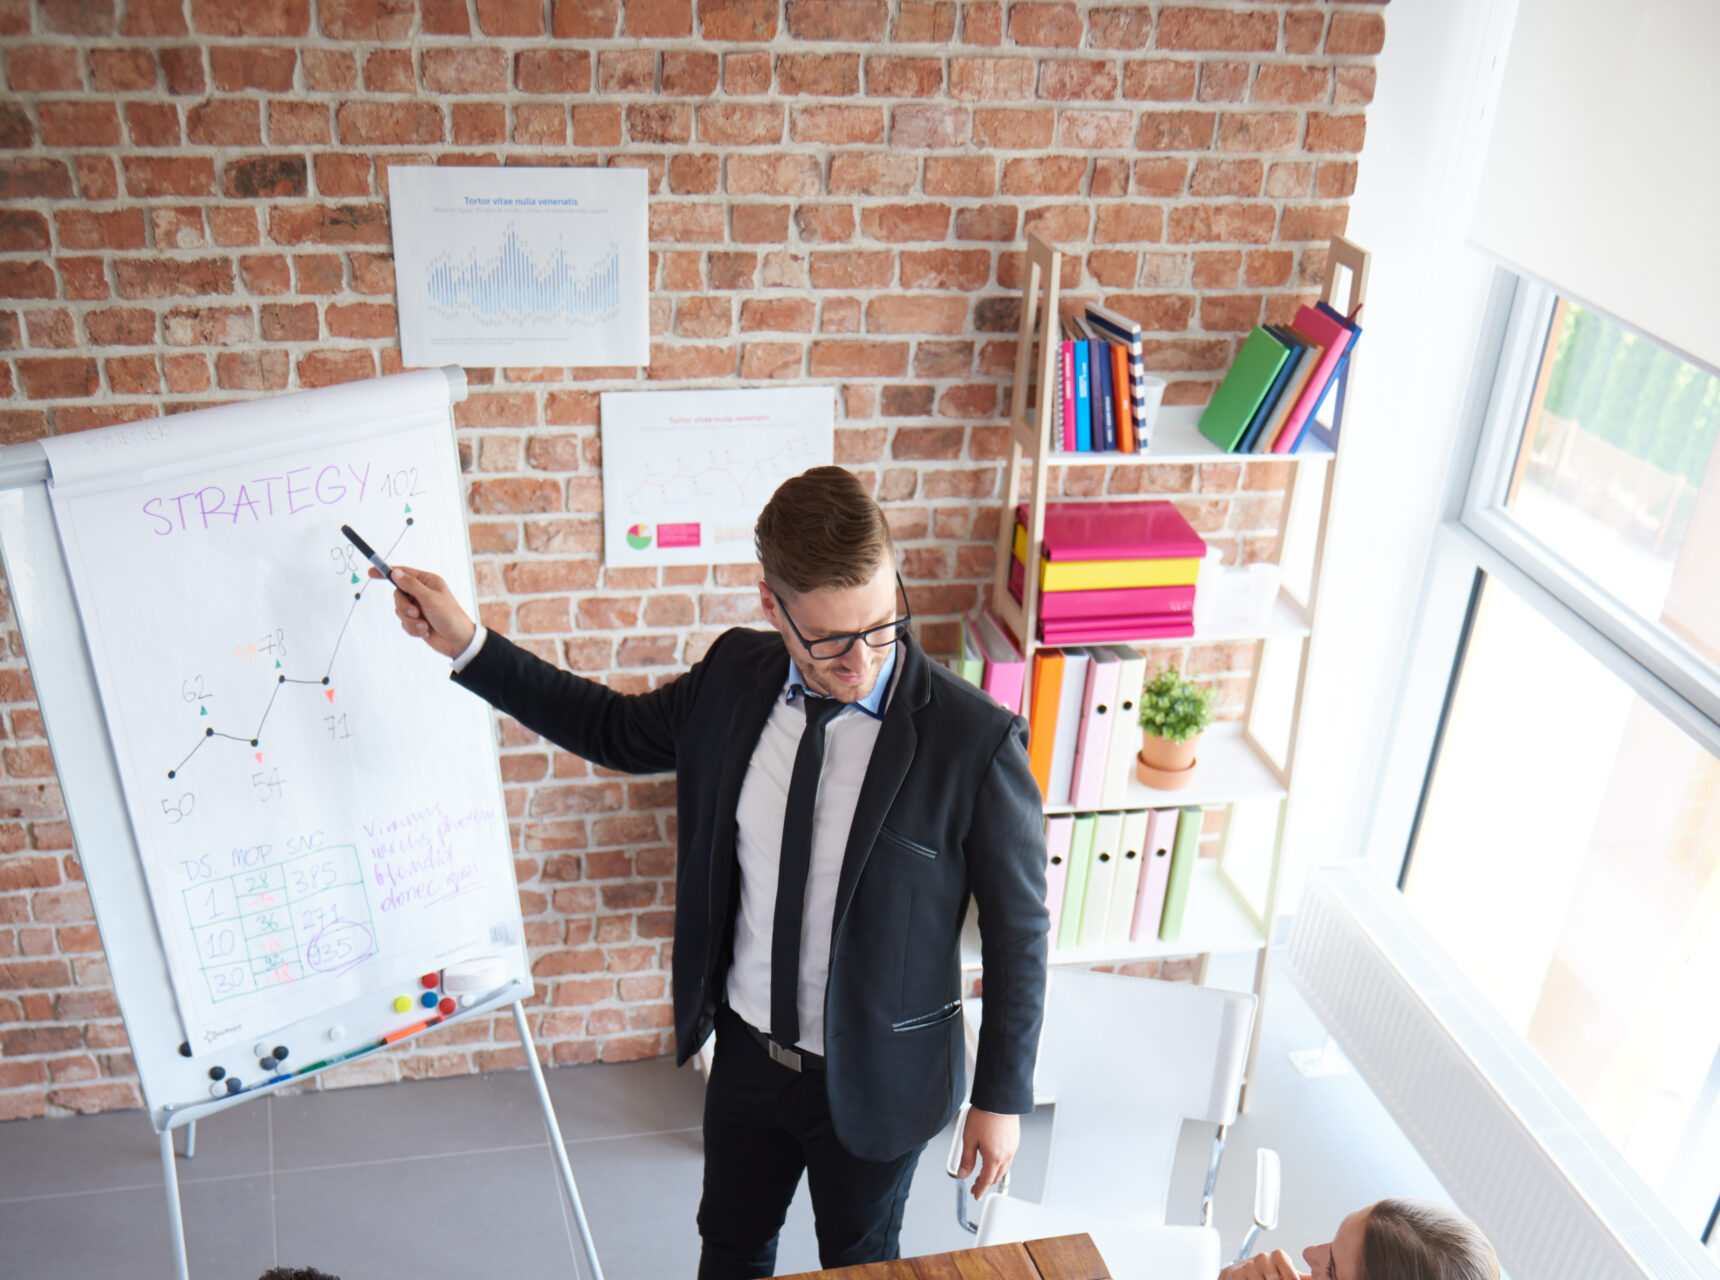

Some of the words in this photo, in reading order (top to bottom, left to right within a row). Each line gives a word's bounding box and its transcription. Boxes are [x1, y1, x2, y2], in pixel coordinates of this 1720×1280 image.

[464, 196, 491, 206] Tortor
[492, 197, 513, 206] vitae
[515, 197, 536, 206] nulla
[538, 197, 579, 206] venenatis
[380, 467, 427, 498] 102
[142, 462, 370, 535] STRATEGY
[330, 543, 358, 575] 98
[182, 674, 214, 702] 62
[323, 712, 355, 740] 71
[252, 767, 286, 802] 54
[161, 792, 195, 824] 50
[245, 871, 269, 893] 28
[291, 861, 337, 893] 385
[205, 887, 224, 920] 1
[302, 903, 346, 930] 271
[256, 912, 278, 932] 36
[207, 928, 235, 960] 10
[214, 967, 244, 993] 30
